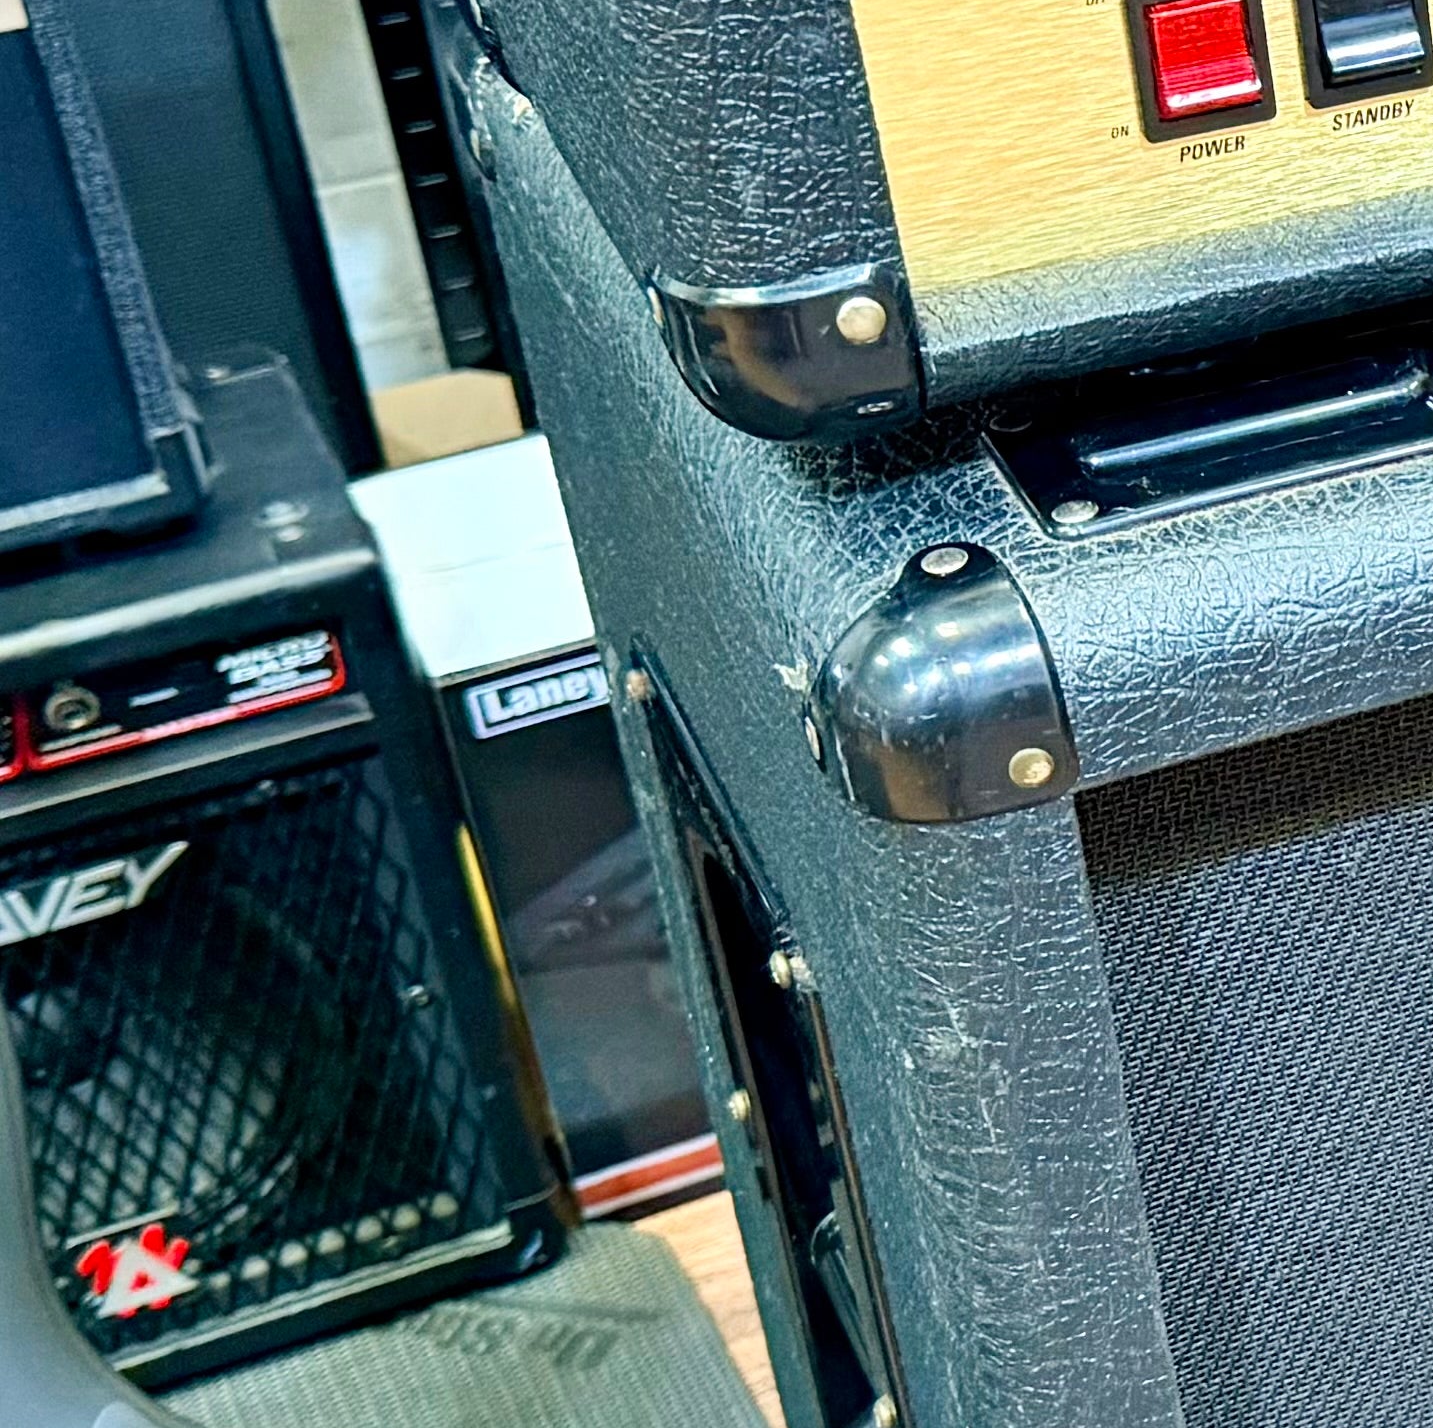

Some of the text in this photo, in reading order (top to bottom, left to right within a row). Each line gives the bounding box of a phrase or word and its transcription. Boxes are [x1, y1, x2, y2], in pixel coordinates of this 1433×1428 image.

[1332, 99, 1415, 132] STANDBY
[1111, 125, 1130, 140] ON
[1179, 134, 1246, 163] POWER
